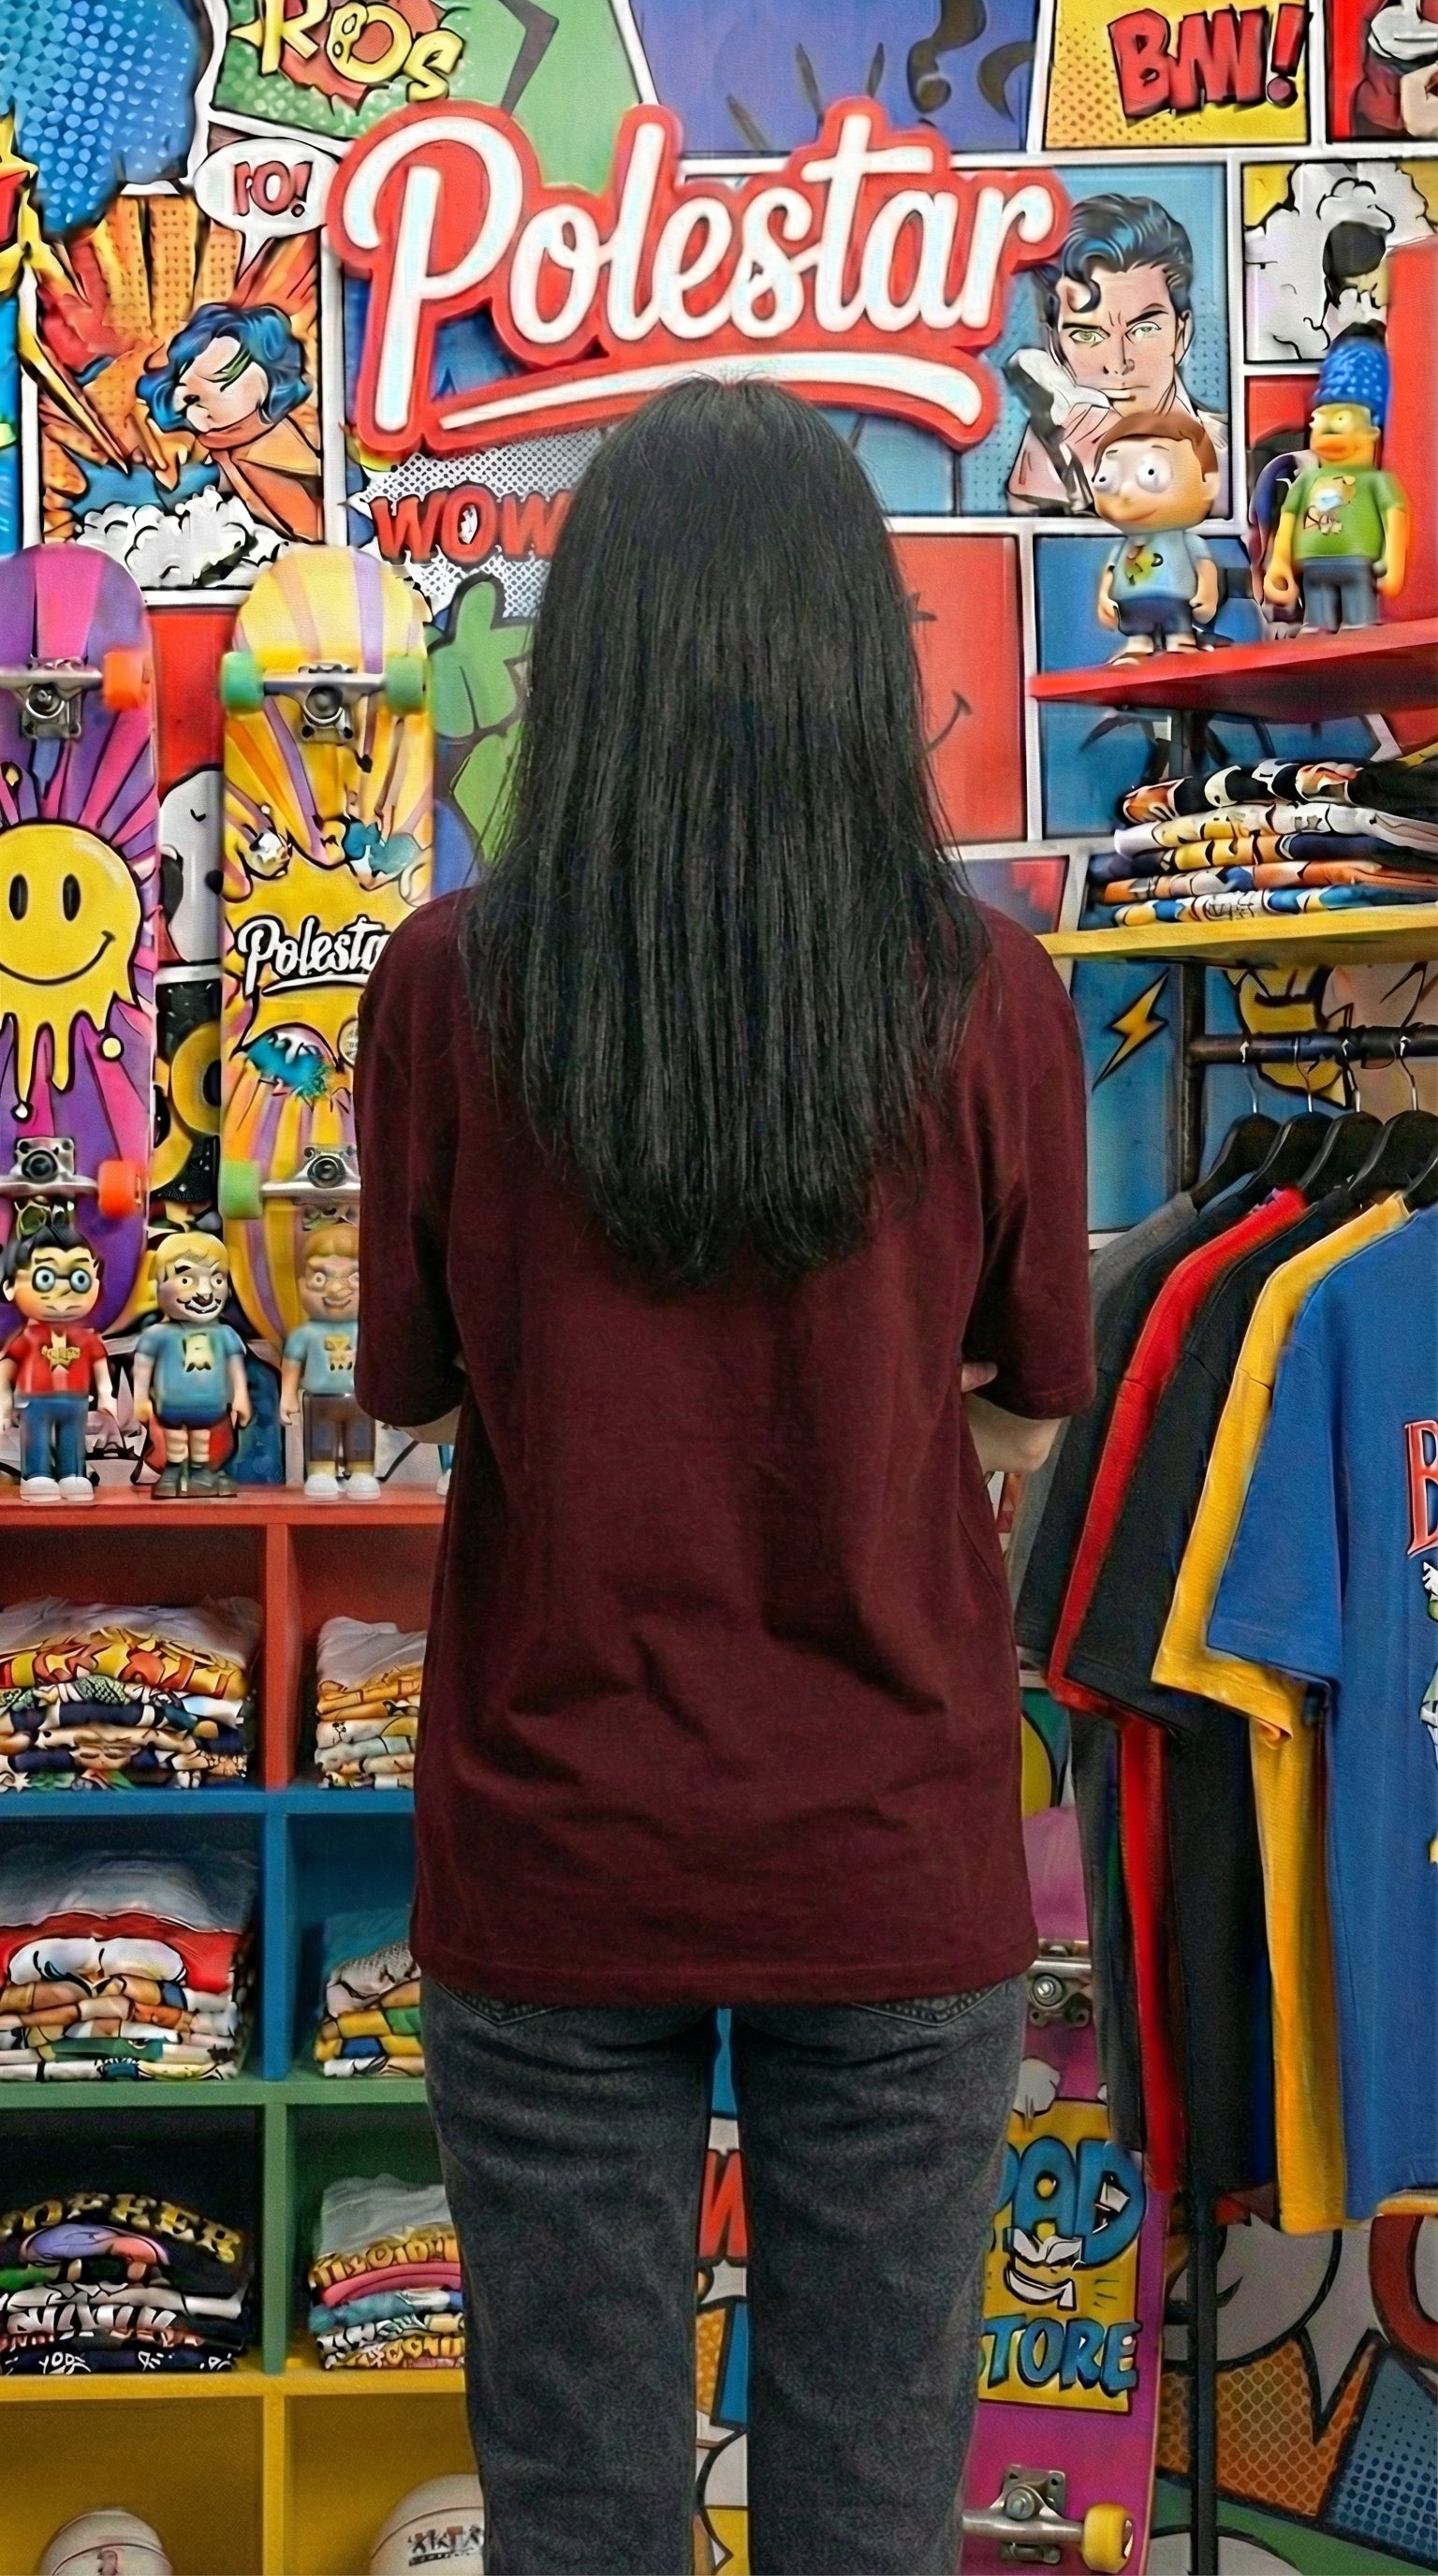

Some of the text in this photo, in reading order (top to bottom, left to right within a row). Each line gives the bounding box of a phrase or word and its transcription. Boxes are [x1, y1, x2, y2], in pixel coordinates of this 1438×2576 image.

[343, 114, 1054, 432] Polestar
[369, 480, 575, 567] WOW
[236, 914, 391, 998] Polesta
[979, 2313, 1142, 2398] TORE
